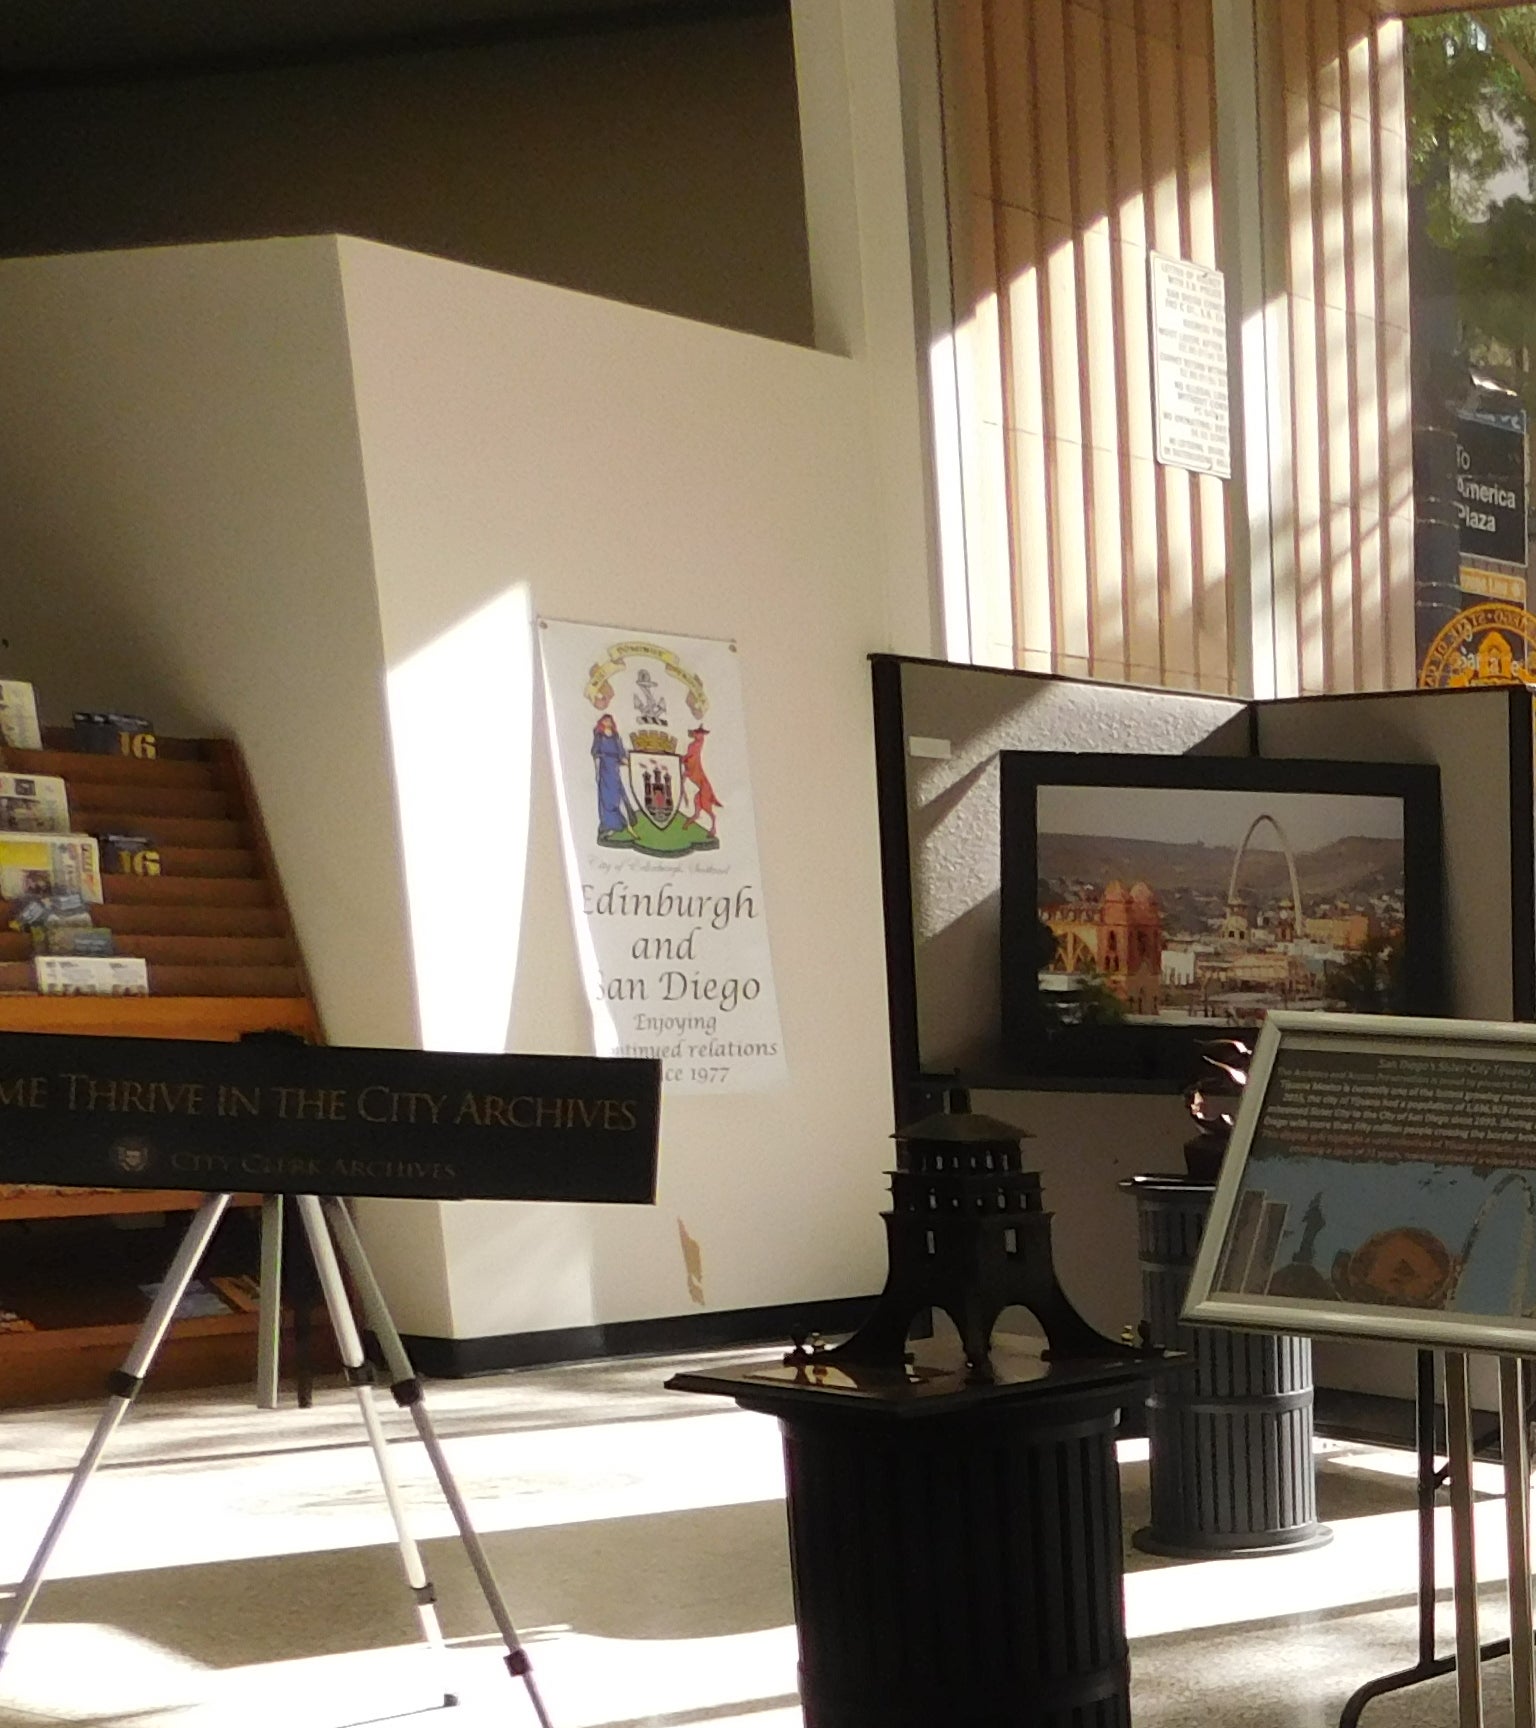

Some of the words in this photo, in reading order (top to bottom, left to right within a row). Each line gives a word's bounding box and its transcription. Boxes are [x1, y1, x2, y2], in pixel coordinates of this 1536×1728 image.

[1457, 476, 1516, 509] America
[117, 731, 158, 760] 16
[119, 850, 161, 876] 16
[583, 881, 760, 930] Edinburgh
[632, 926, 703, 960] and
[659, 971, 760, 1012] Diego
[634, 1014, 717, 1035] Enjoying
[688, 1038, 778, 1059] relations
[691, 1067, 730, 1083] 1977
[60, 1073, 205, 1116] THRIVE
[217, 1085, 261, 1118] IN
[271, 1086, 349, 1120] THE
[357, 1085, 448, 1125] CITY
[454, 1090, 637, 1132] ARCHIVES
[171, 1151, 228, 1174] CITY
[242, 1153, 321, 1176] CLERK
[335, 1157, 456, 1180] ARCHIVES
